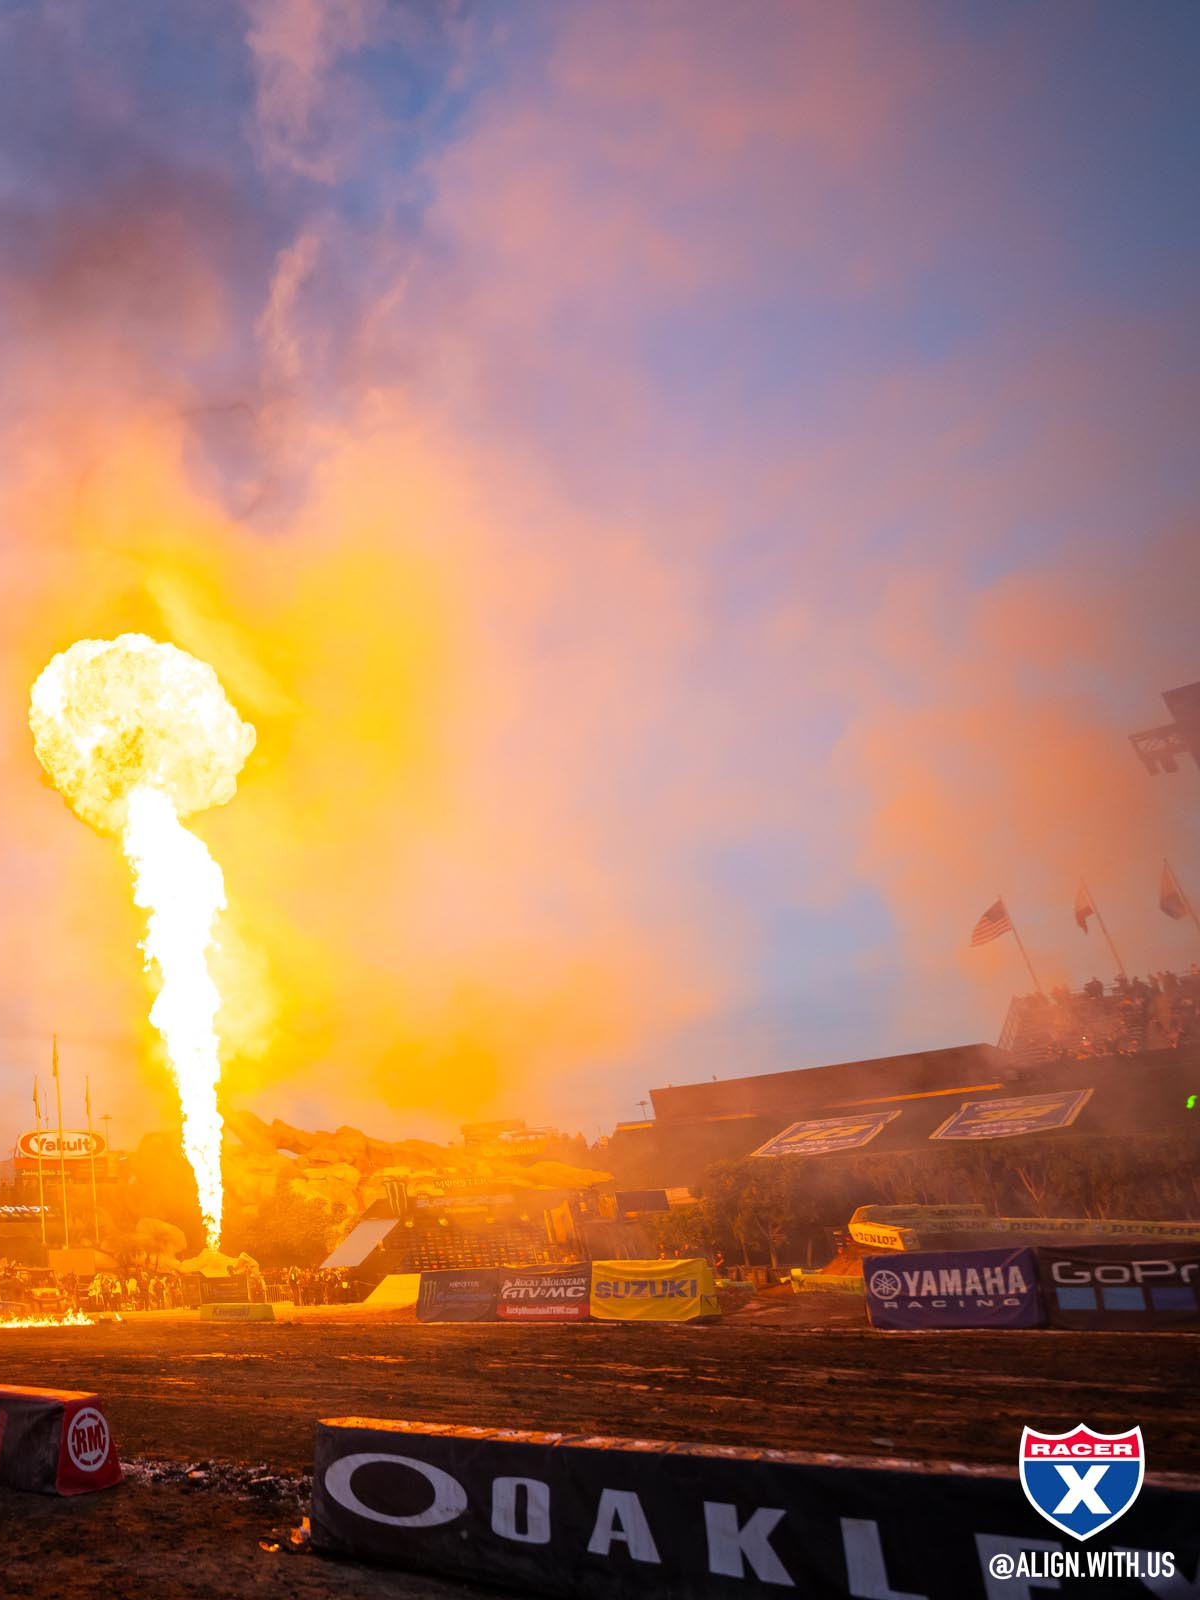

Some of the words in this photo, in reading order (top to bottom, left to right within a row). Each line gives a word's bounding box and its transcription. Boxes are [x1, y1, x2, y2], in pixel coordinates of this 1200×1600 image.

[34, 1137, 93, 1152] Yakult
[540, 1276, 588, 1287] MOUNTAIN
[902, 1265, 1028, 1297] YAMAHA
[594, 1279, 698, 1299] SUZUKI
[883, 1297, 1021, 1309] RACING
